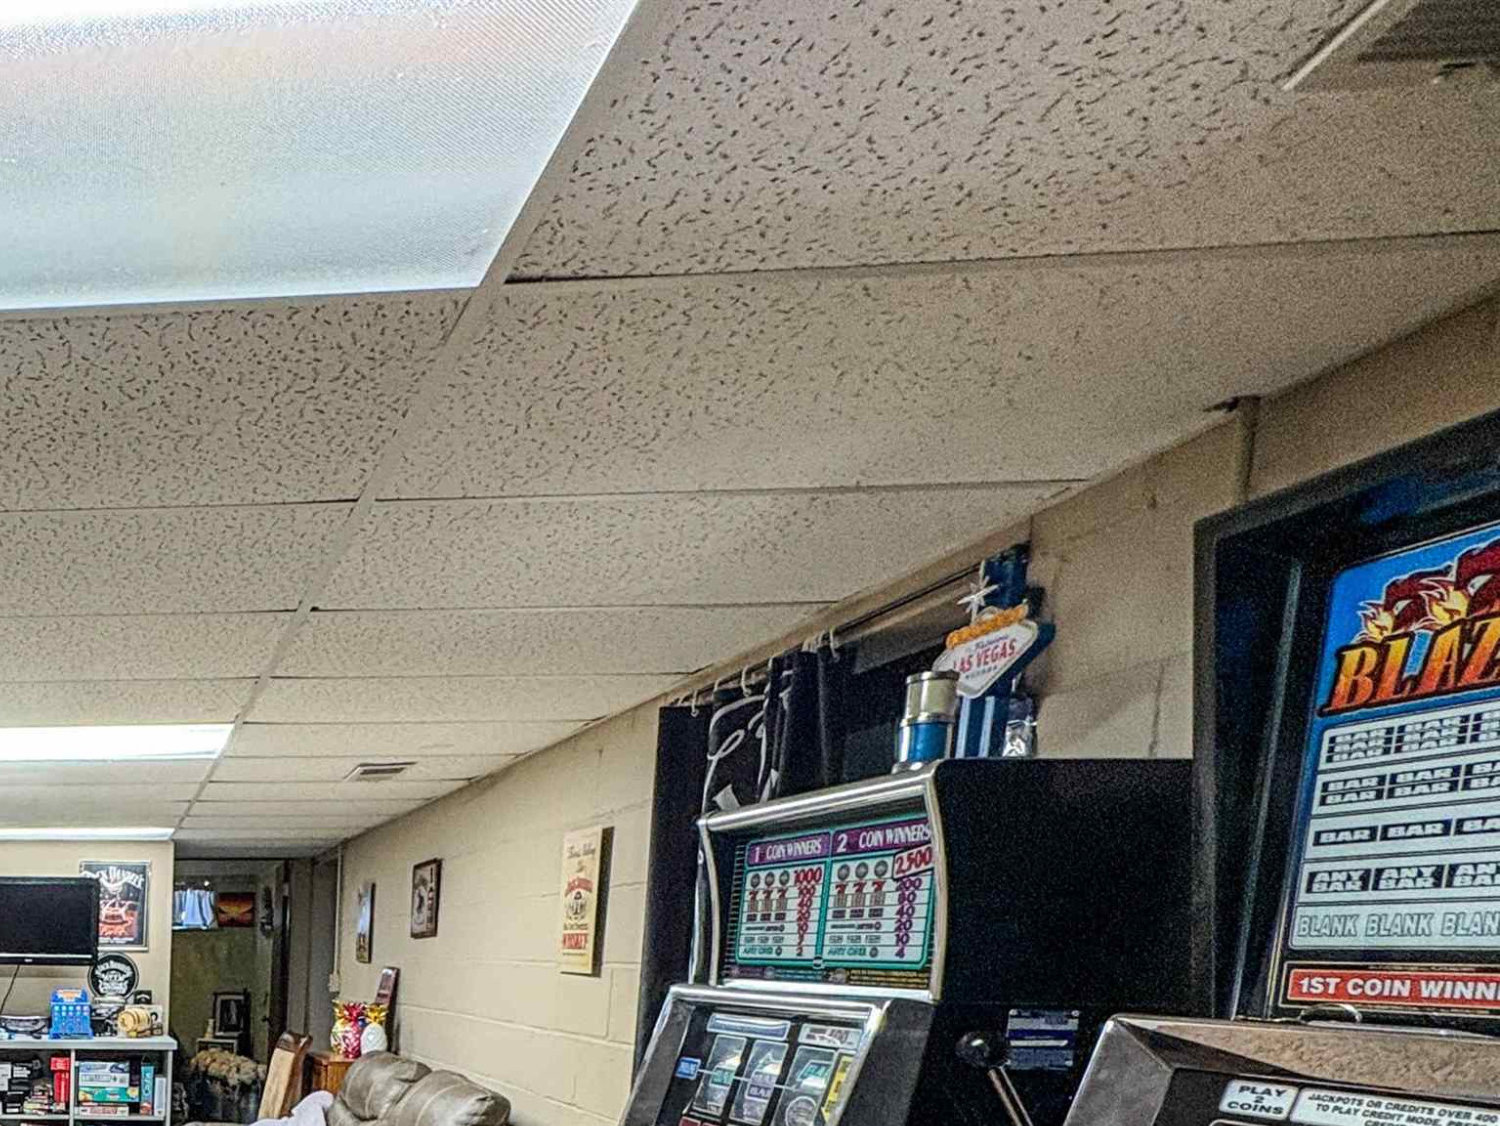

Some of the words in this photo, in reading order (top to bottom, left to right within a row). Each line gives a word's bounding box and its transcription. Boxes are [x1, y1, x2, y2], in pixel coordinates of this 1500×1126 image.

[976, 638, 1016, 667] VEGAS
[1328, 777, 1379, 792] BAR
[1396, 768, 1453, 783] BAR
[1325, 791, 1377, 804] BAR
[1394, 782, 1451, 797] BAR
[837, 833, 848, 853] 2
[859, 830, 884, 848] COIN
[885, 822, 931, 844] WINNERS
[1321, 829, 1371, 843] BAR
[1387, 823, 1444, 838] BAR
[895, 846, 932, 876] 2,500
[1311, 880, 1363, 892] BAR
[1378, 876, 1434, 890] BAR
[1313, 870, 1365, 882] ANY
[1380, 866, 1436, 879] ANY
[1297, 914, 1359, 938] BLANK
[1365, 911, 1433, 937] BLANK
[1299, 977, 1342, 994] 1ST
[1346, 978, 1410, 998] COIN
[1238, 1086, 1287, 1097] PLAY
[1253, 1095, 1265, 1104] 2
[1227, 1101, 1284, 1115] COINS
[1308, 1093, 1364, 1108] JACKPOTS
[1384, 1101, 1434, 1116] CREDITS
[1438, 1108, 1471, 1121] OVER
[1475, 1113, 1498, 1124] 400
[1316, 1103, 1329, 1112] TO
[1332, 1106, 1360, 1118] PLAY
[1362, 1109, 1404, 1122] CREDIT
